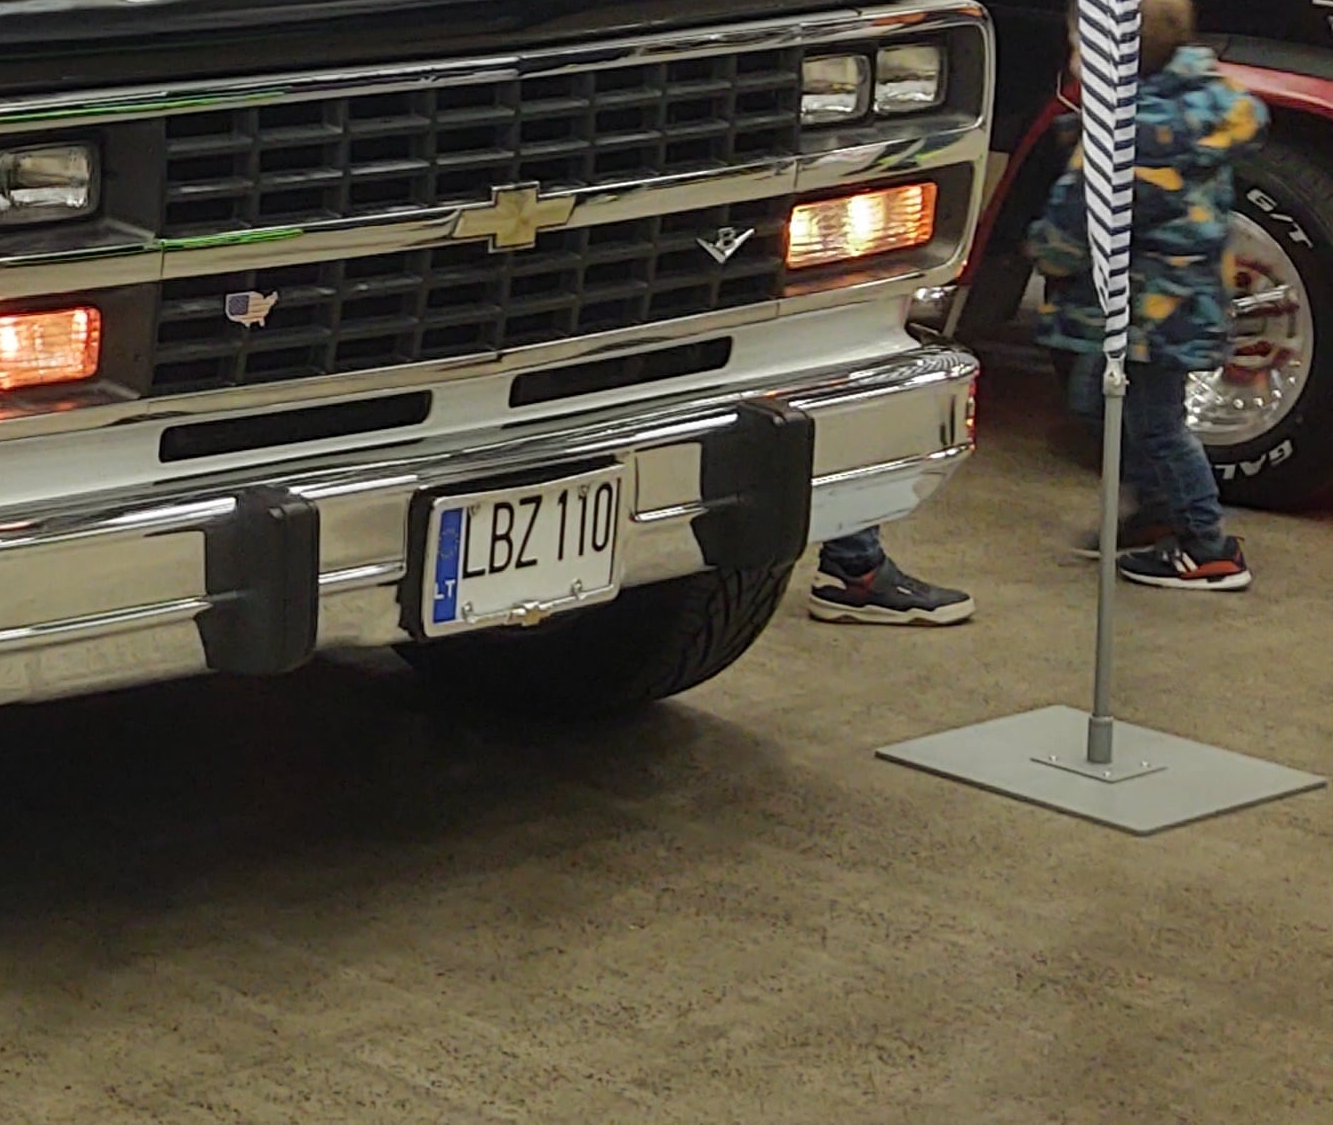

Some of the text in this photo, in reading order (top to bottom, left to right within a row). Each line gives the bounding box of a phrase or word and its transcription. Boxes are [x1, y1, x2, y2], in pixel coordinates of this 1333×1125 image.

[462, 481, 613, 580] LBZ 110
[434, 579, 456, 600] LT
